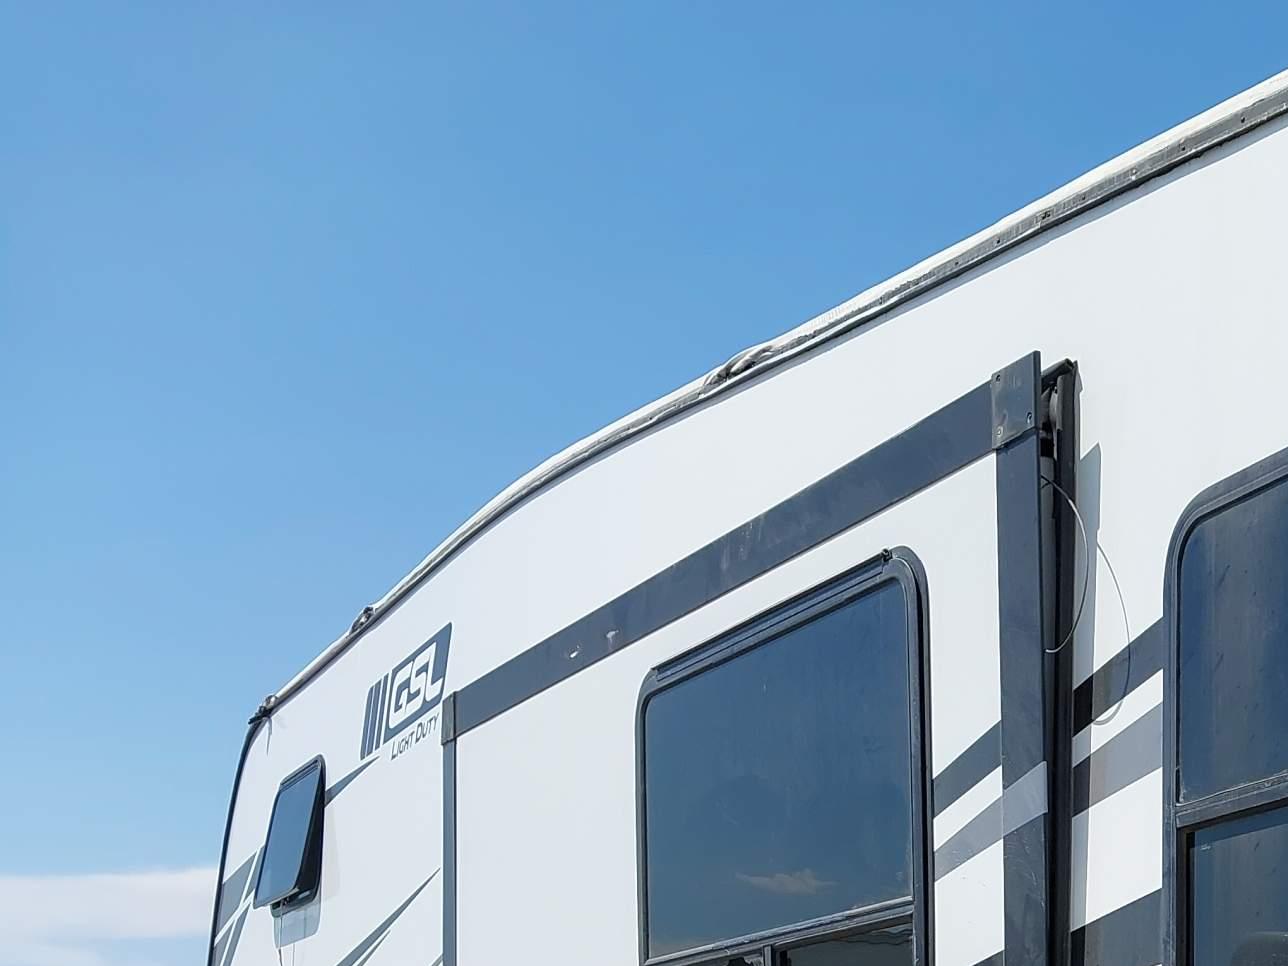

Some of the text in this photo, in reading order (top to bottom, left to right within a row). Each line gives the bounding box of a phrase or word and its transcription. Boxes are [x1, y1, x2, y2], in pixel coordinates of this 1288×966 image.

[388, 641, 444, 729] GSL
[390, 714, 440, 761] LIGHT DUTY
